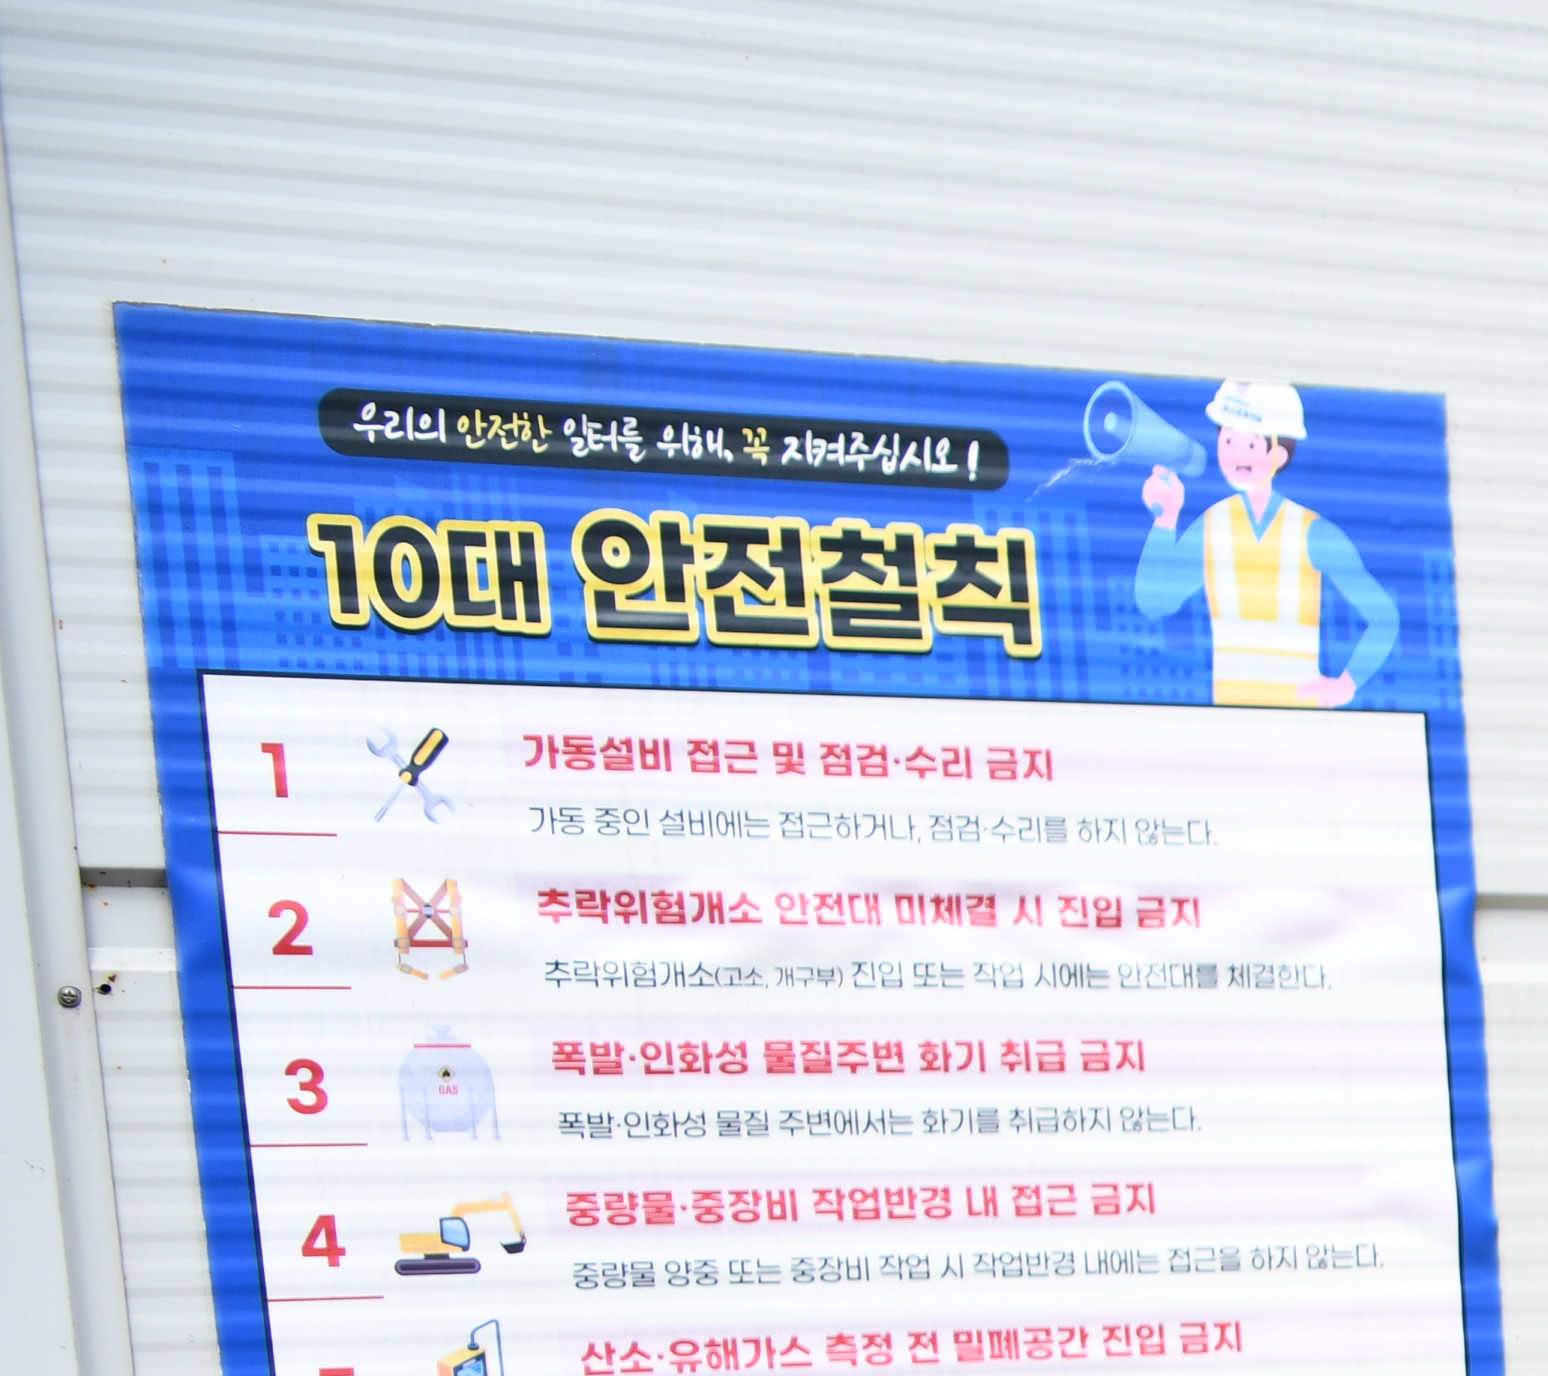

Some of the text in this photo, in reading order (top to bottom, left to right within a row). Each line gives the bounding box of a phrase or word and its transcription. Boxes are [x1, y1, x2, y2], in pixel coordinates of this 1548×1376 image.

[354, 402, 445, 442] 우리의
[457, 410, 552, 454] 안전한
[564, 414, 644, 457] 일터를
[657, 424, 732, 463] 위해,
[744, 426, 770, 465] 꼭
[312, 511, 1039, 655] 10대 안전철칙
[261, 743, 289, 798] 1
[523, 735, 1053, 781] 가동설비 접근 및 점검·수리 금지
[529, 807, 1217, 847] 가동 중인 설비에는 접근하거나, 점검·수리를 하지 않는다.
[268, 900, 313, 955] 2
[538, 888, 1202, 929] 추락위험개소 안전대 미체결 시 진입 금지
[776, 967, 843, 988] 개구부)
[852, 962, 903, 988] 진입
[913, 962, 964, 988] 또는
[973, 962, 1024, 988] 작업
[1035, 962, 1110, 989] 시에는
[1117, 963, 1217, 989] 안전대를
[1228, 964, 1332, 991] 체결한다.
[552, 1039, 1146, 1075] 폭발·인화성 물질주변 화기 취급 금지
[285, 1059, 328, 1115] 3
[438, 1084, 459, 1095] GAS
[559, 1106, 1202, 1137] 폭발·인화성 물질 주변에서는 화기를 취급하지 않는다.
[566, 1182, 1156, 1226] 중량물·중장비 작업반경 내 접근 금지
[301, 1215, 345, 1267] 4
[825, 1331, 894, 1366] 측정
[907, 1332, 940, 1365] 전
[953, 1327, 1089, 1362] 밀폐공간
[1102, 1324, 1166, 1358] 진입
[1179, 1321, 1243, 1356] 금지
